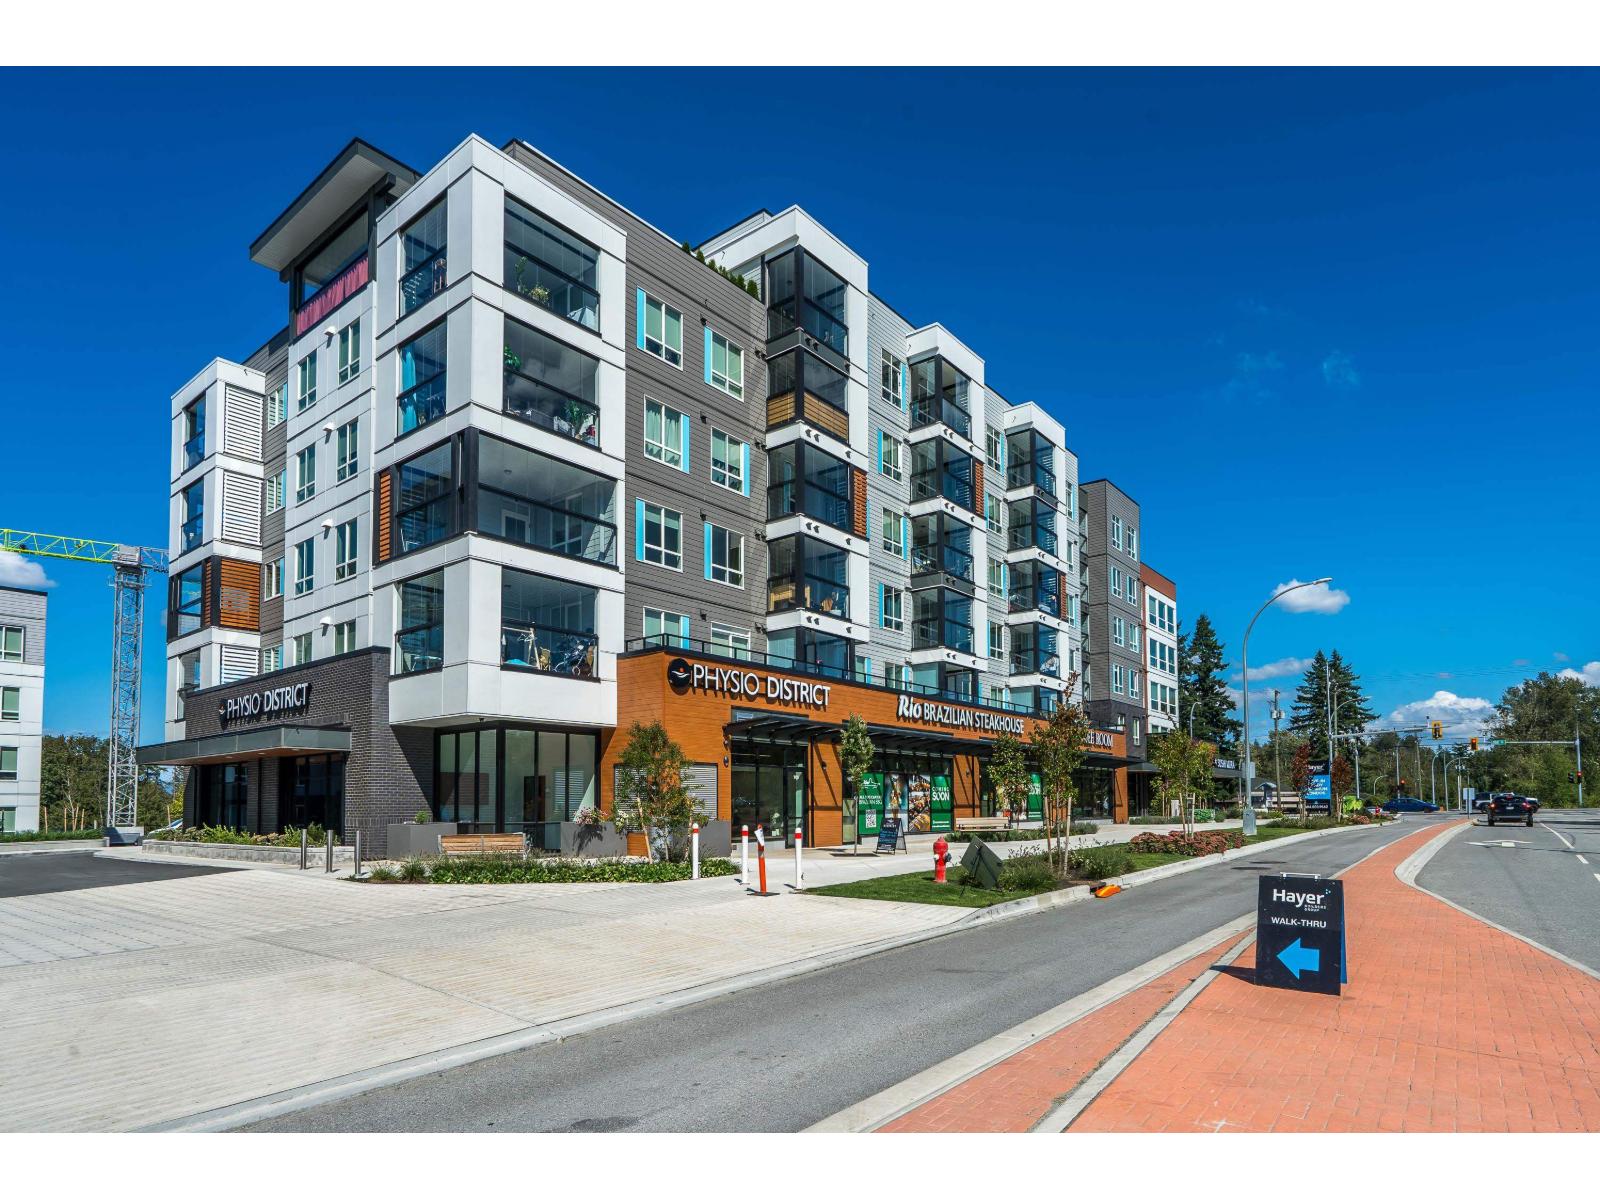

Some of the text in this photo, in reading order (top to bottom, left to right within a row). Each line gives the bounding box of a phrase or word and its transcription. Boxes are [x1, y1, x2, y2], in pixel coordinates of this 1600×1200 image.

[693, 664, 831, 706] PHYSIO DISTRICT
[227, 682, 309, 719] PHYSIO DISTRICT
[898, 695, 1025, 734] Rio BRAZILIAN STEAKHOUSE
[1095, 732, 1113, 747] ROOM
[932, 792, 950, 801] SOON
[1272, 889, 1325, 908] Hayer
[1271, 916, 1327, 929] WALK-THRU
